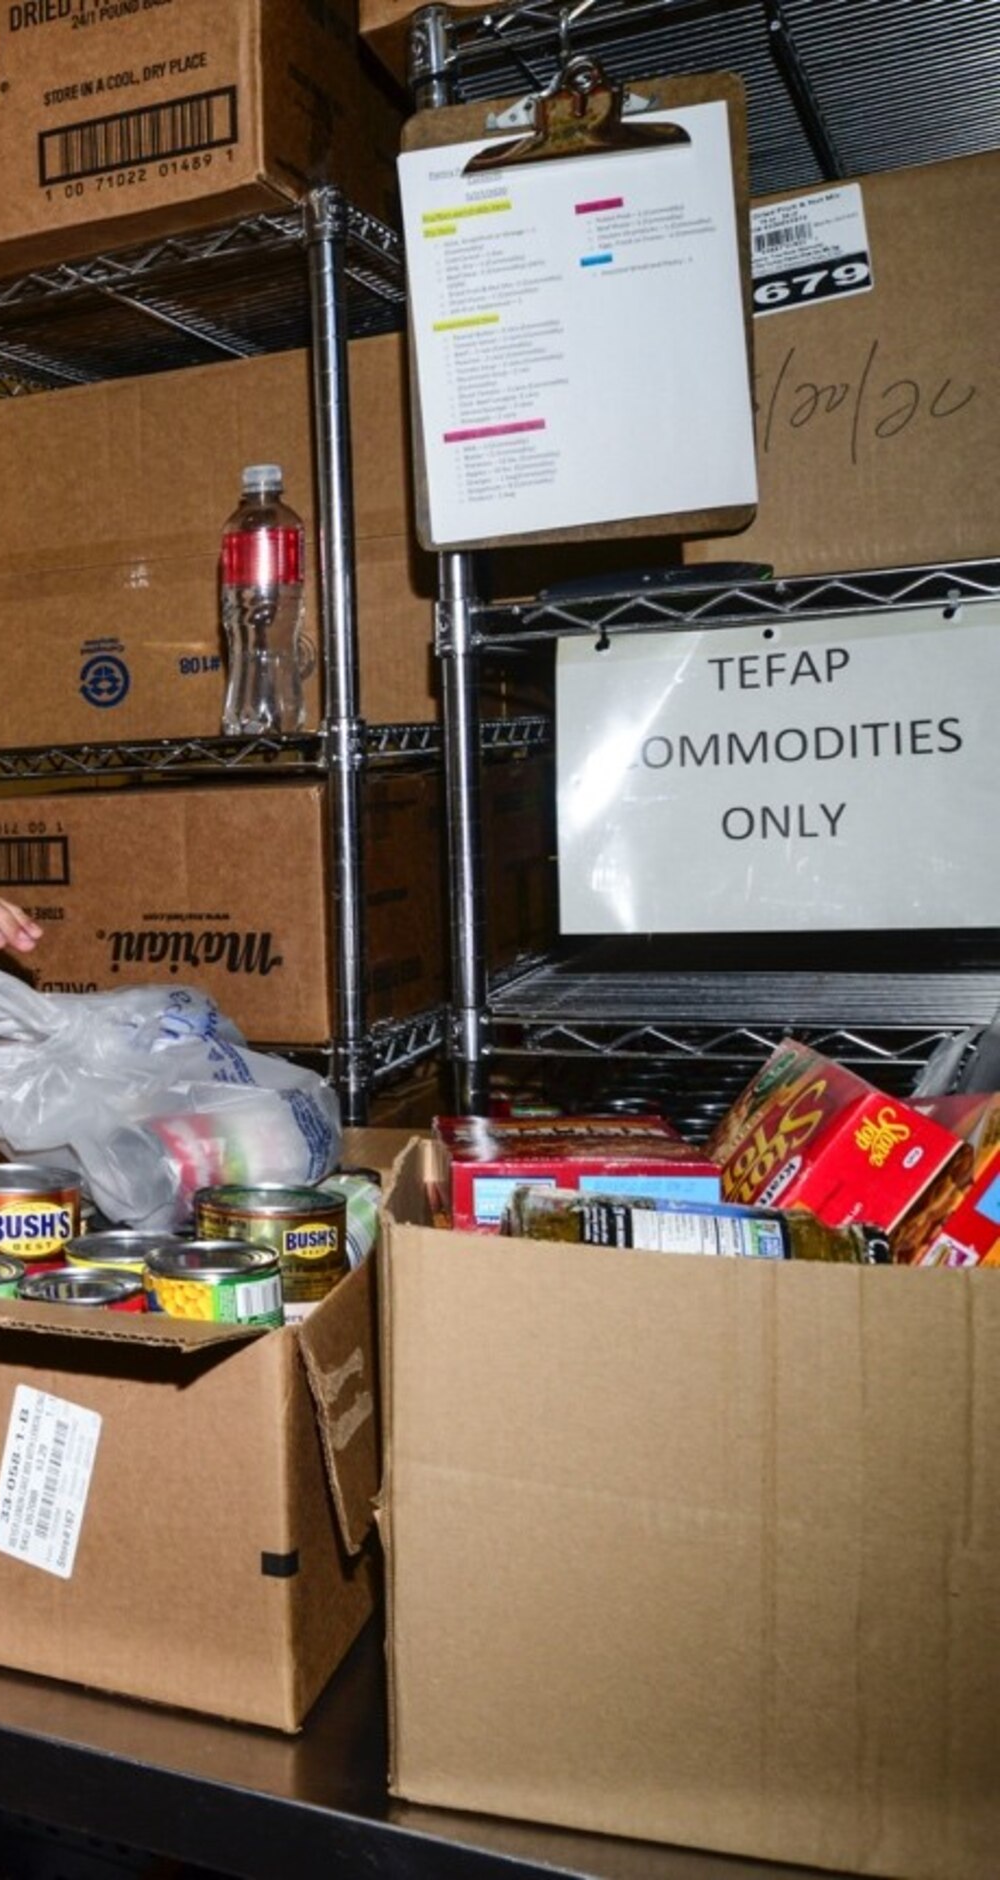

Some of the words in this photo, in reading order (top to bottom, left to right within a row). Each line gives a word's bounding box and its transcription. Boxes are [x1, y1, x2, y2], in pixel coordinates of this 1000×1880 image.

[9, 0, 72, 32] DRIED
[100, 0, 140, 22] POUND
[44, 86, 79, 106] STORE
[80, 81, 94, 97] IN
[96, 79, 105, 94] A
[106, 71, 141, 90] COOL,
[143, 61, 167, 81] DRY
[169, 52, 208, 75] PLACE
[45, 189, 53, 202] 1
[64, 182, 85, 199] 00
[96, 169, 148, 191] 71022
[226, 149, 235, 162] 1
[753, 262, 870, 305] 679
[179, 655, 221, 675] #108
[708, 647, 851, 691] TEFAP
[634, 717, 963, 769] OMMODITIES
[28, 821, 47, 834] 00
[721, 803, 847, 840] ONLY
[34, 907, 65, 920] STORE
[110, 930, 283, 977] Mariani
[854, 1115, 880, 1151] Top
[868, 1106, 911, 1168] Stove
[13, 1241, 53, 1251] BEST
[286, 1227, 337, 1251] BUSH'S
